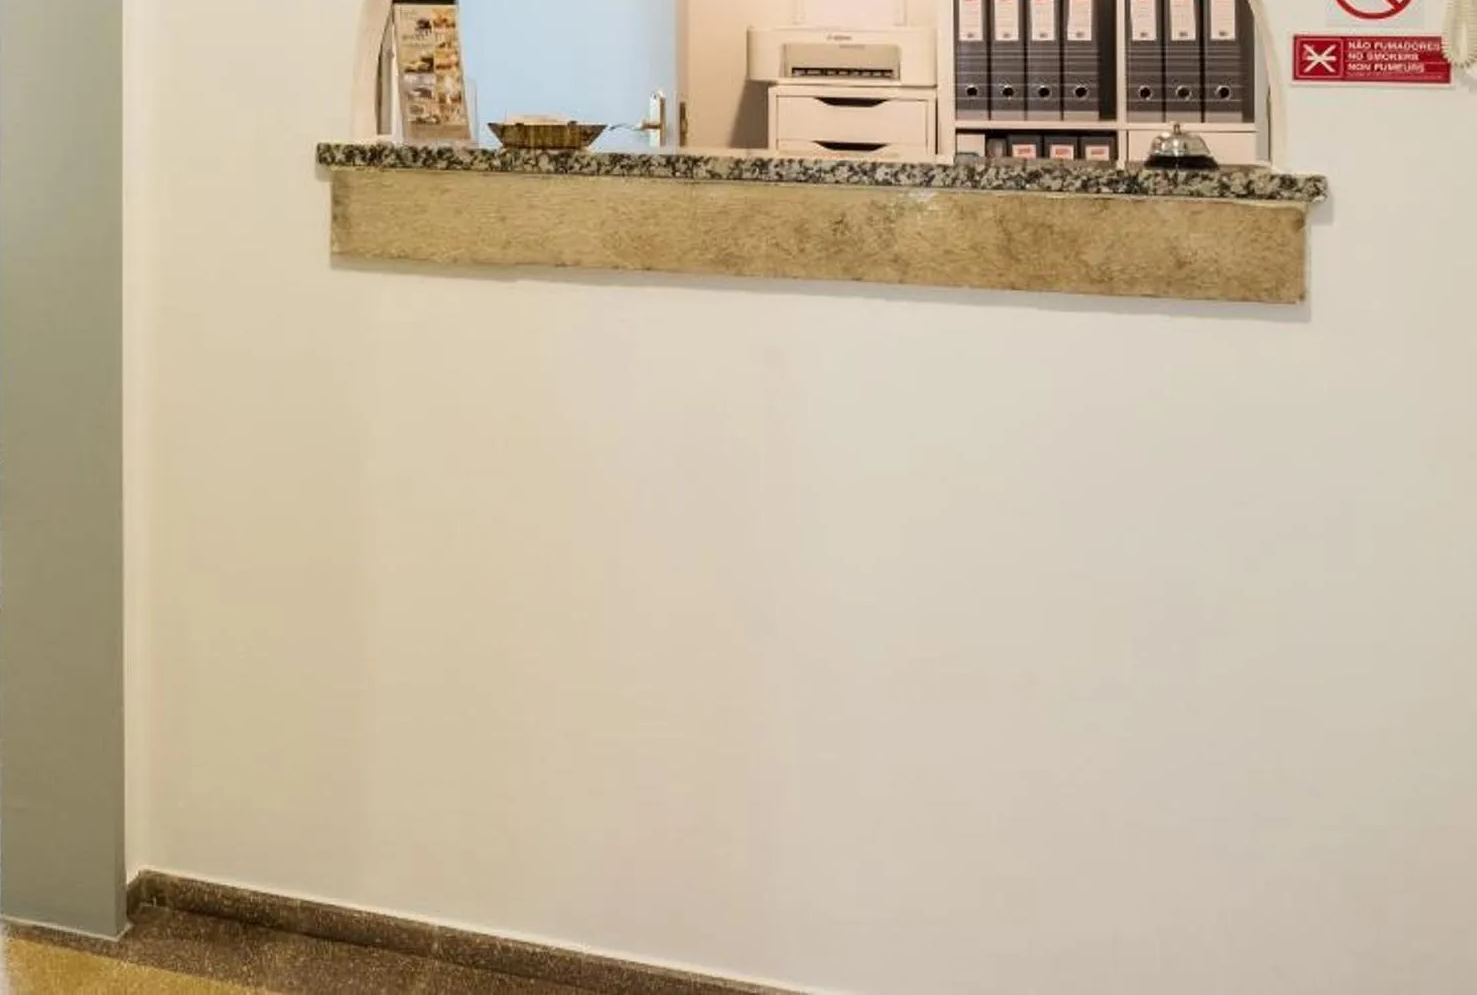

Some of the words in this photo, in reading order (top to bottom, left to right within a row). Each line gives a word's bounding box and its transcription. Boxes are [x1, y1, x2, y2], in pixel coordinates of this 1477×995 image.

[1348, 39, 1372, 51] NÃO
[1348, 51, 1364, 61] NO
[1366, 51, 1419, 62] SMOKERS
[1348, 62, 1372, 72] NON
[1374, 62, 1425, 73] FUMEURS
